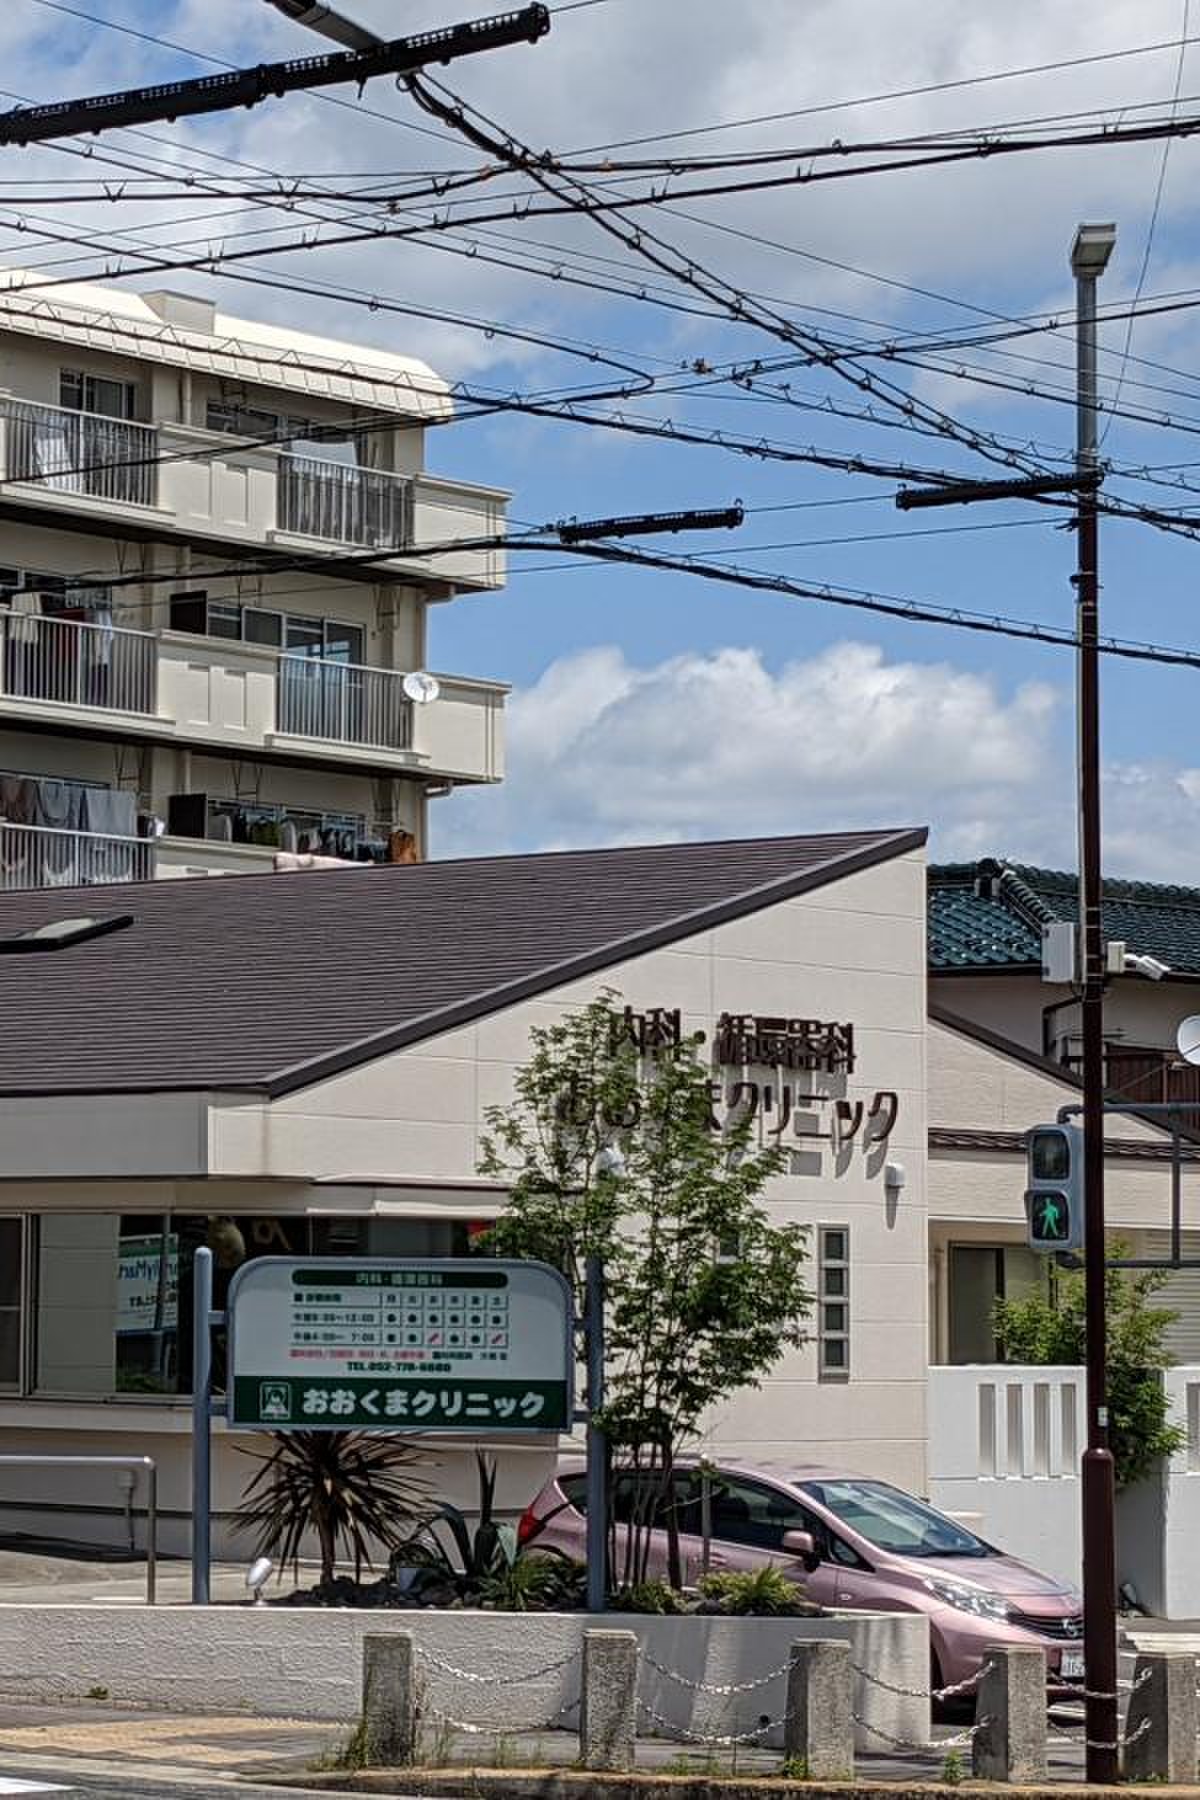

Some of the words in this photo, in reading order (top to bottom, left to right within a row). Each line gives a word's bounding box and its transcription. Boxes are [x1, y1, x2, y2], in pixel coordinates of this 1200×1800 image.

[302, 1388, 546, 1418] おおくまクリニック
